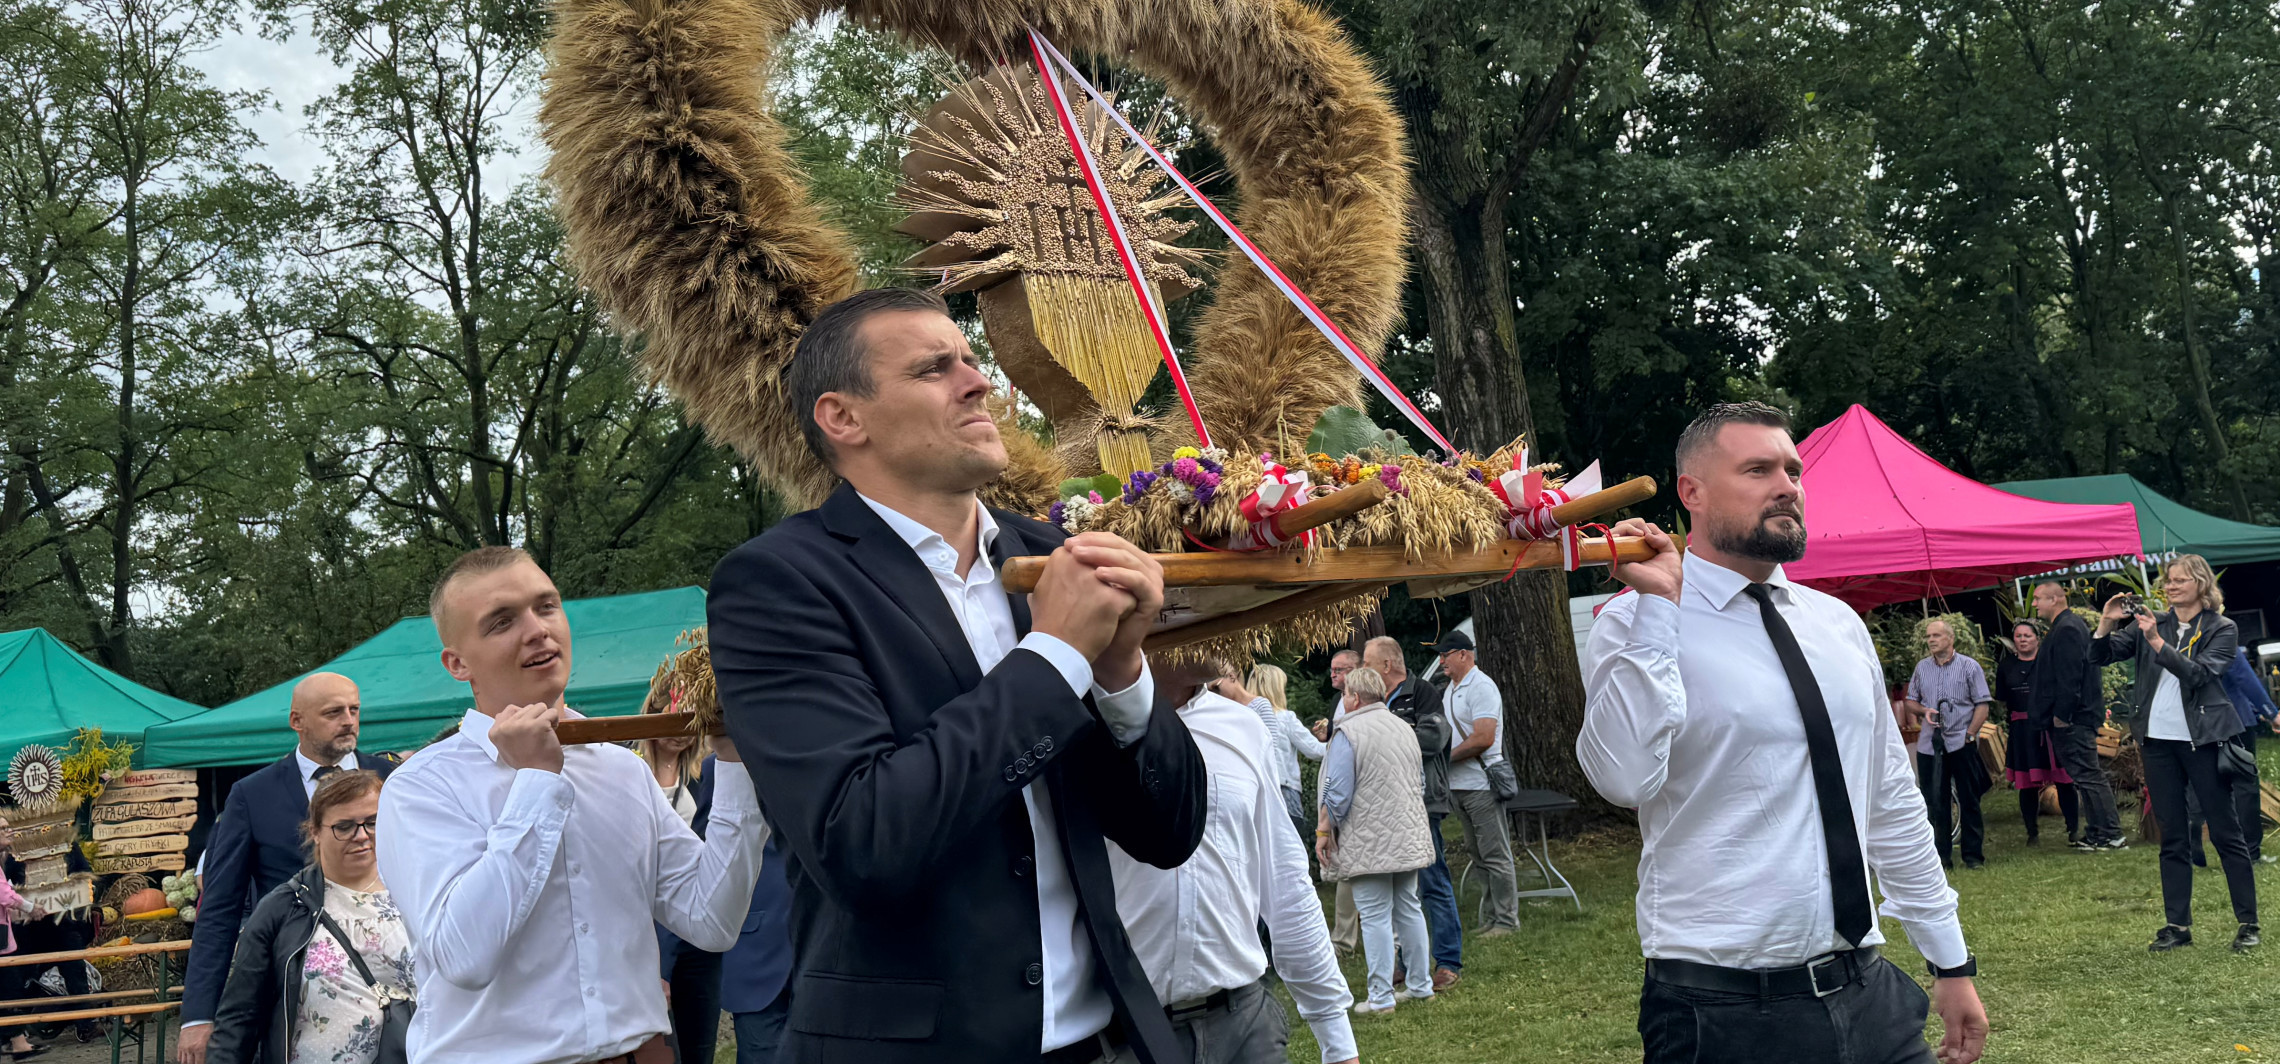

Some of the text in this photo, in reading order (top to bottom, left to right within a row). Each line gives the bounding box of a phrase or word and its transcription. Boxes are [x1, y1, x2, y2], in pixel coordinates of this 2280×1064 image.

[26, 769, 49, 787] IHS
[92, 803, 176, 820] ZUPA GULASZOWA
